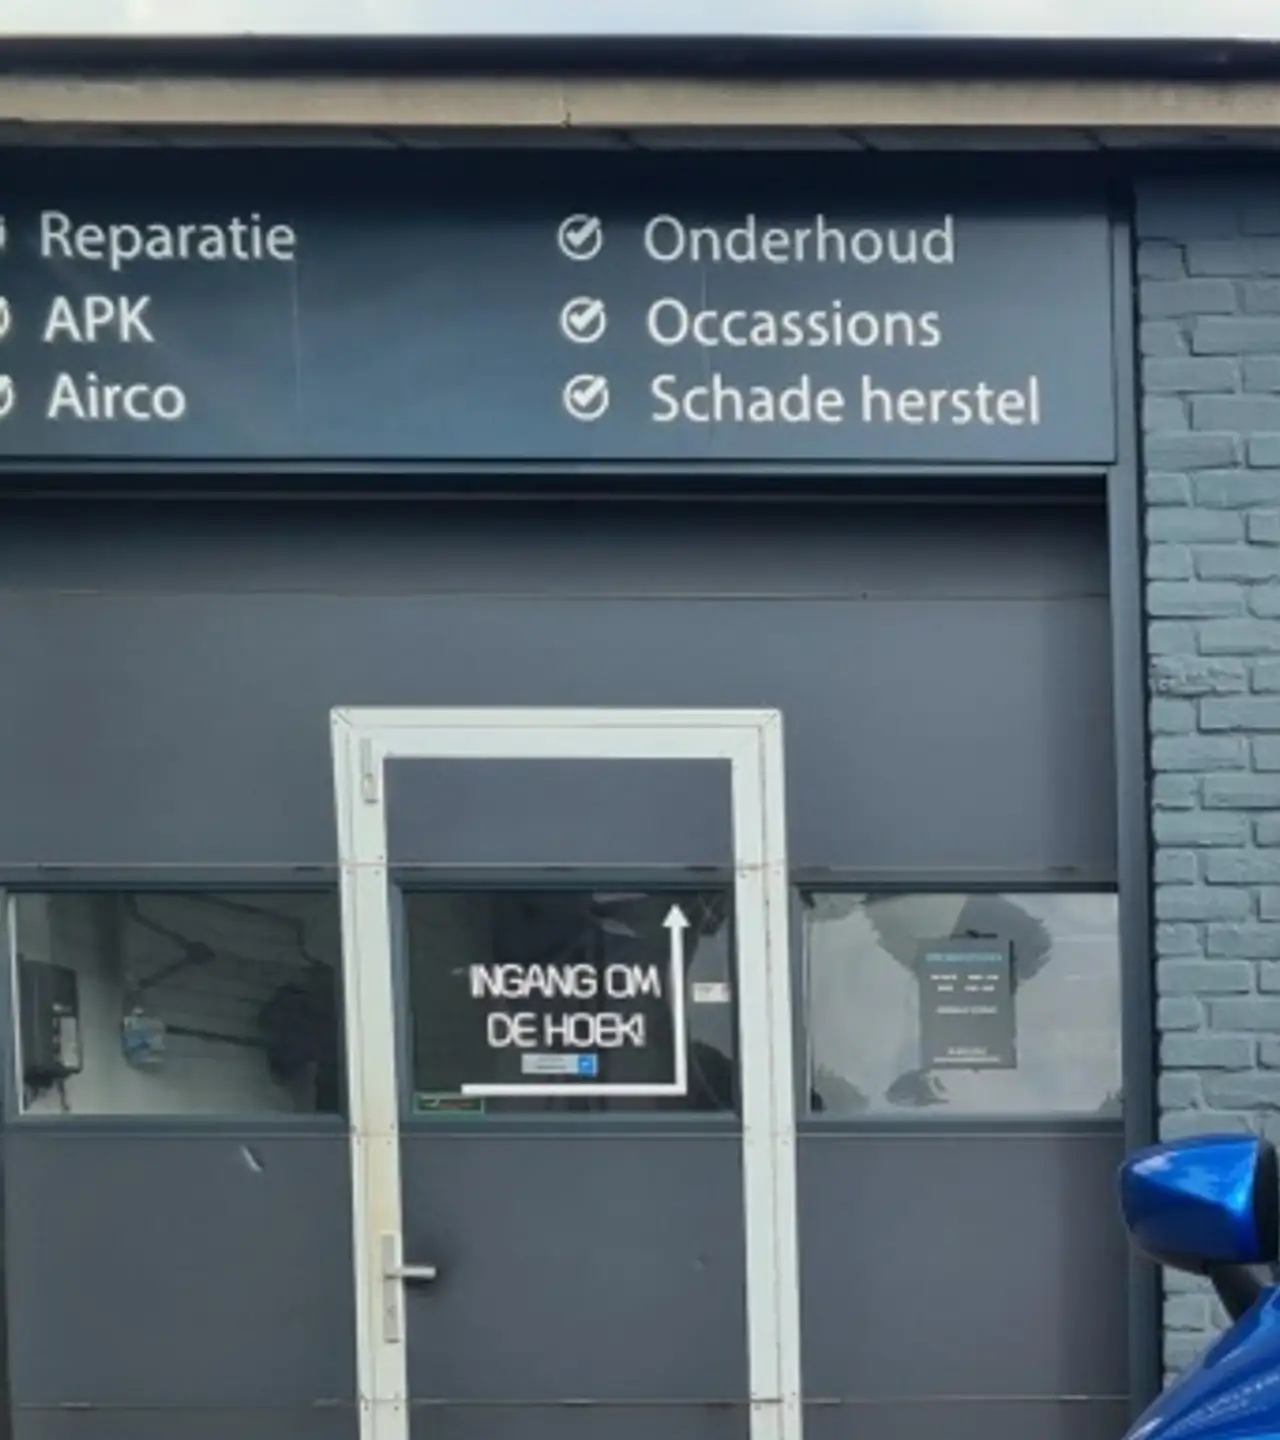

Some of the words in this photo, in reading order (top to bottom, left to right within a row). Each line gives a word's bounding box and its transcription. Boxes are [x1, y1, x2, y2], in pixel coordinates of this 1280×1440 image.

[40, 209, 297, 272] Reparatie
[643, 213, 956, 265] Onderhoud
[43, 294, 156, 345] APK
[646, 296, 943, 349] Occassions
[47, 371, 187, 422] Airco
[650, 372, 844, 425] Schade
[860, 373, 1041, 427] herstel
[470, 963, 598, 998] INGANG
[604, 963, 662, 998] OM
[486, 1012, 538, 1047] DE
